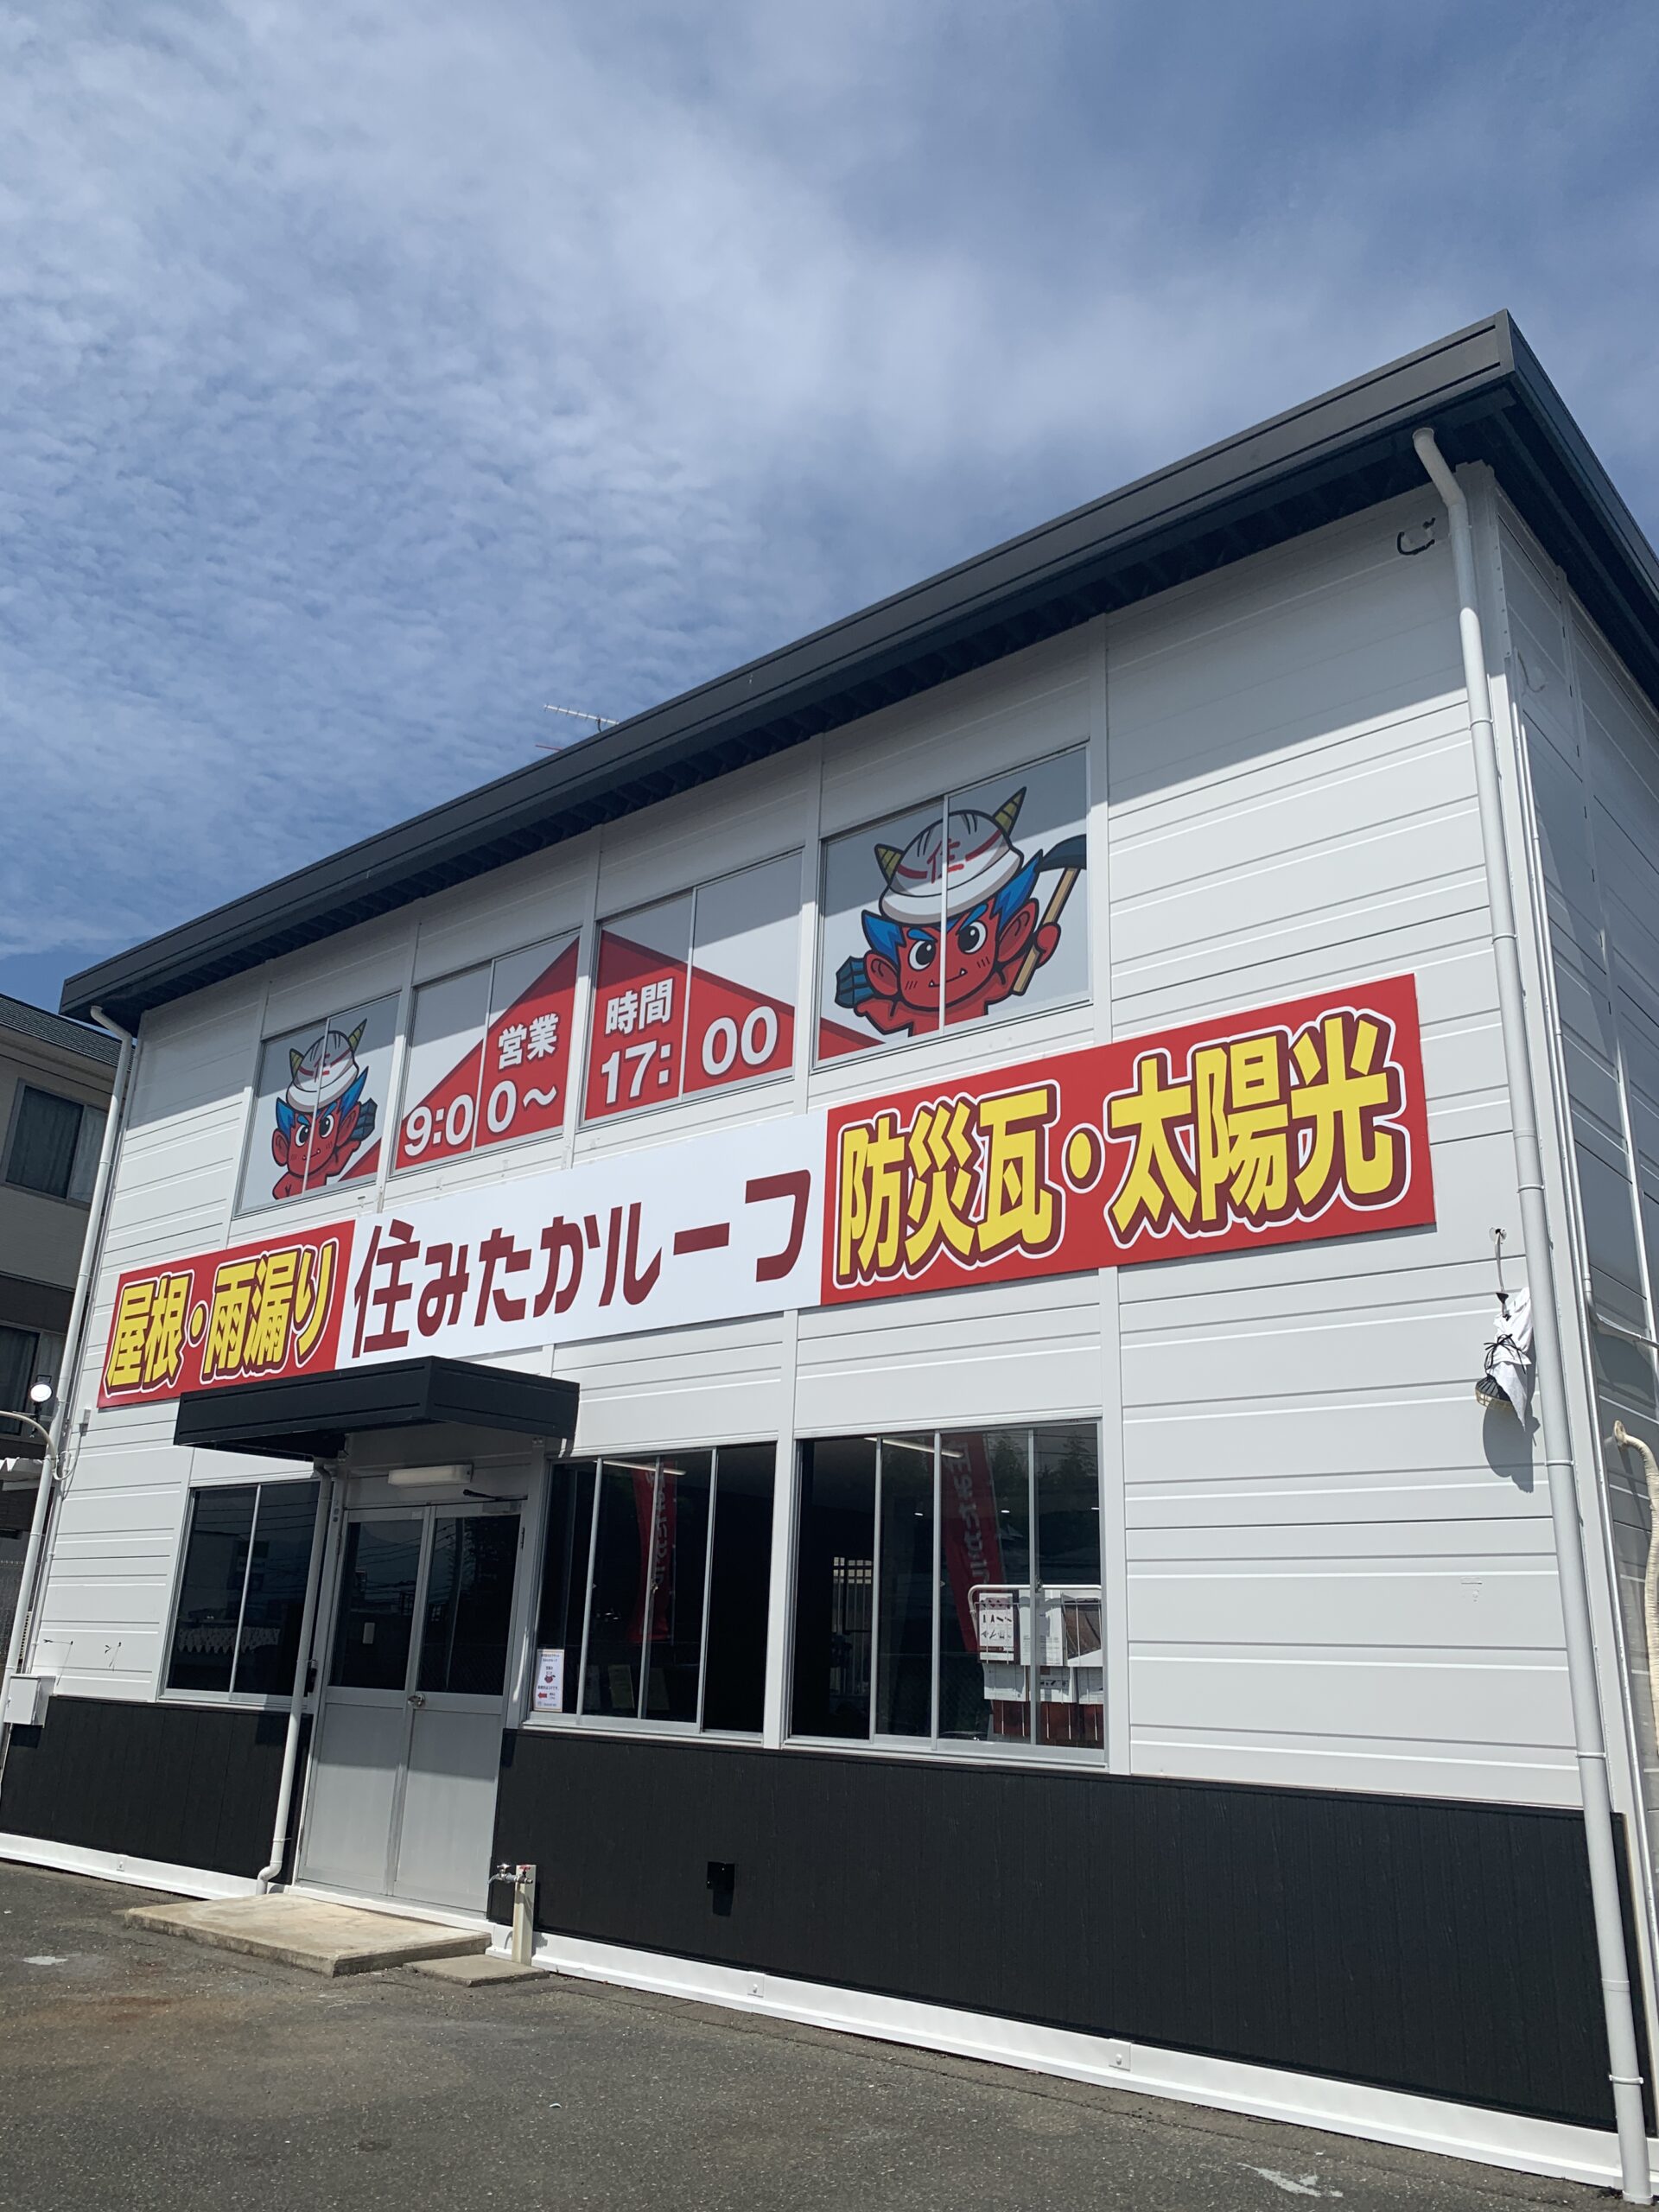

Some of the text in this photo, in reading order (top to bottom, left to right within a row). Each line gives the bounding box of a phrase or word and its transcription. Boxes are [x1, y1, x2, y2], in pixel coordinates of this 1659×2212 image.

[499, 977, 674, 1071] 営業 時間
[601, 1006, 779, 1104] 17:00
[837, 1014, 1400, 1282] 防災瓦・太陽光
[103, 1239, 338, 1392] 屋根・雨漏り
[353, 1169, 811, 1359] 住みたかルーフ
